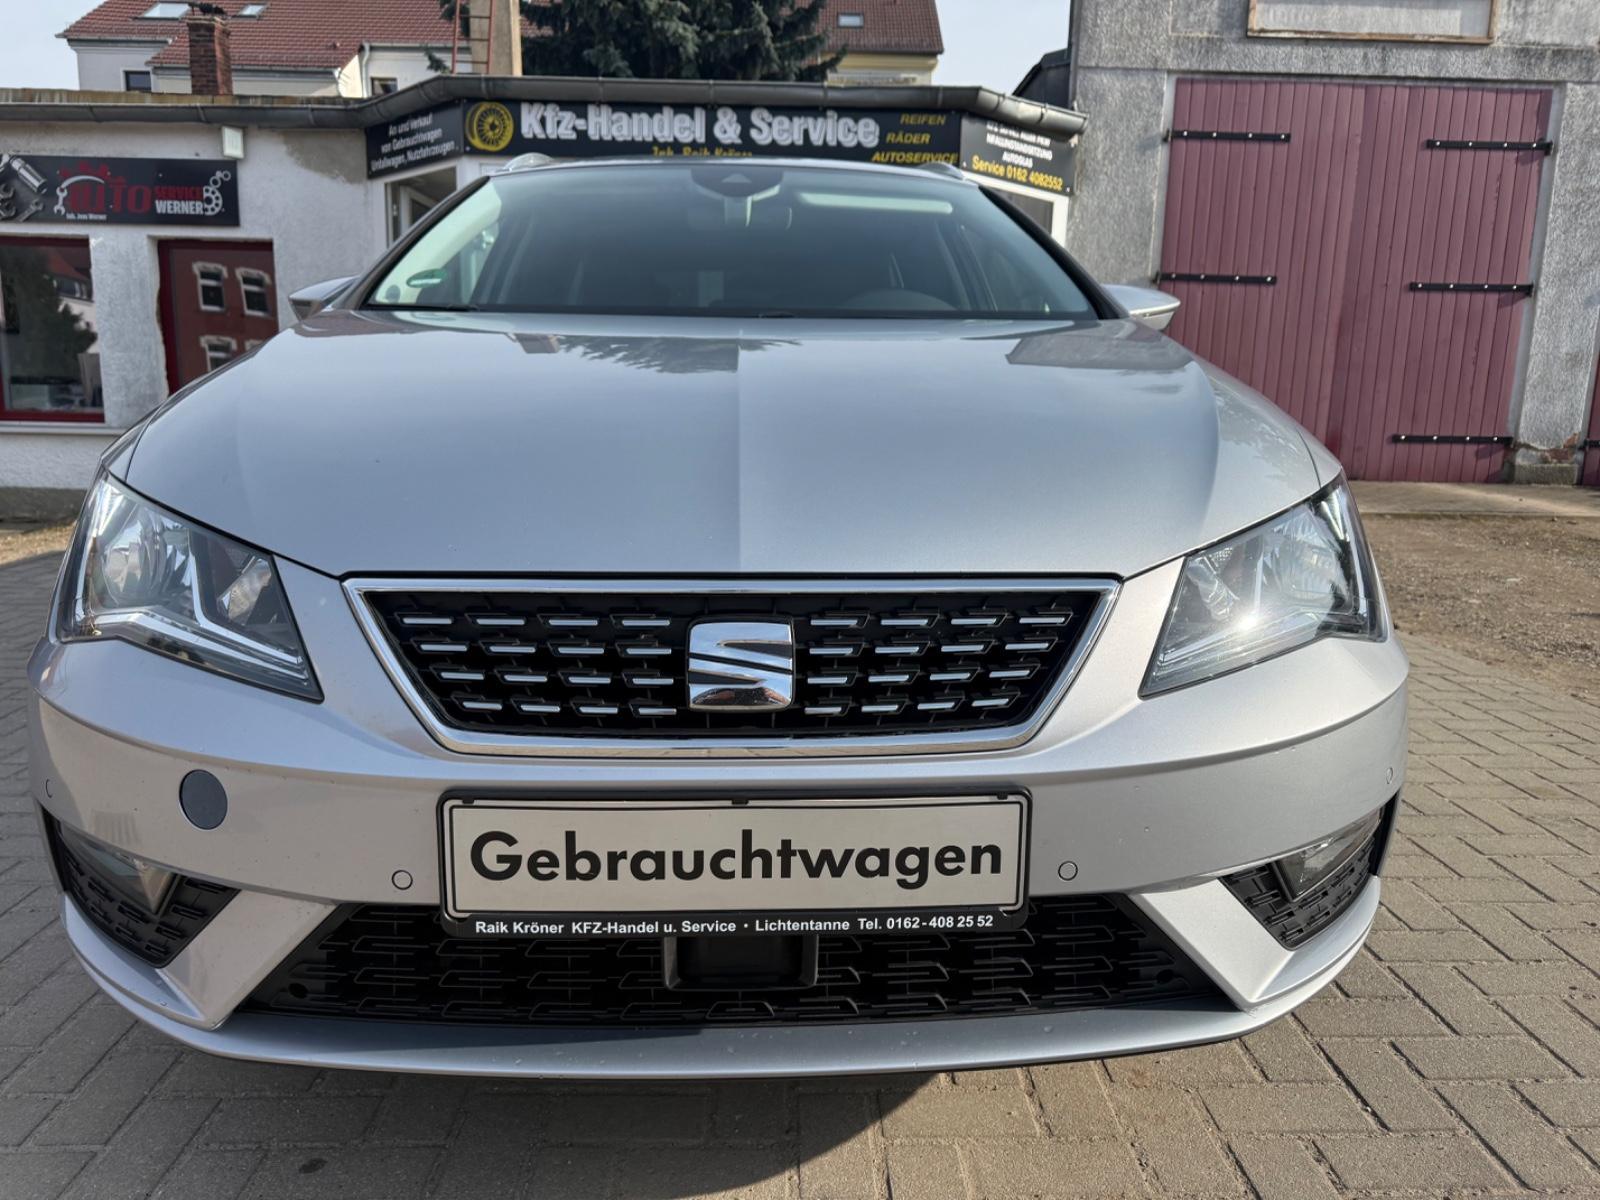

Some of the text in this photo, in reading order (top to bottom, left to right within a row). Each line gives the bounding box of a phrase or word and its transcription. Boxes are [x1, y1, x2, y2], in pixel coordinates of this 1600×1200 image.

[520, 102, 880, 148] Kfz-Handel & Service
[901, 113, 946, 126] REIFEN
[886, 132, 931, 144] RÄDER
[871, 151, 959, 164] AUTOSERVICE
[971, 154, 1005, 177] Service
[1006, 164, 1027, 181] 0162
[155, 199, 204, 216] WERNER
[469, 829, 1002, 890] Gebrauchtwagen
[475, 920, 509, 934] Raik
[513, 921, 565, 934] Kröner
[571, 921, 659, 934] KFZ-Handel
[663, 922, 677, 933] u.
[681, 920, 736, 932] Service
[755, 919, 850, 931] Lichtentanne
[858, 918, 882, 930] Tel.
